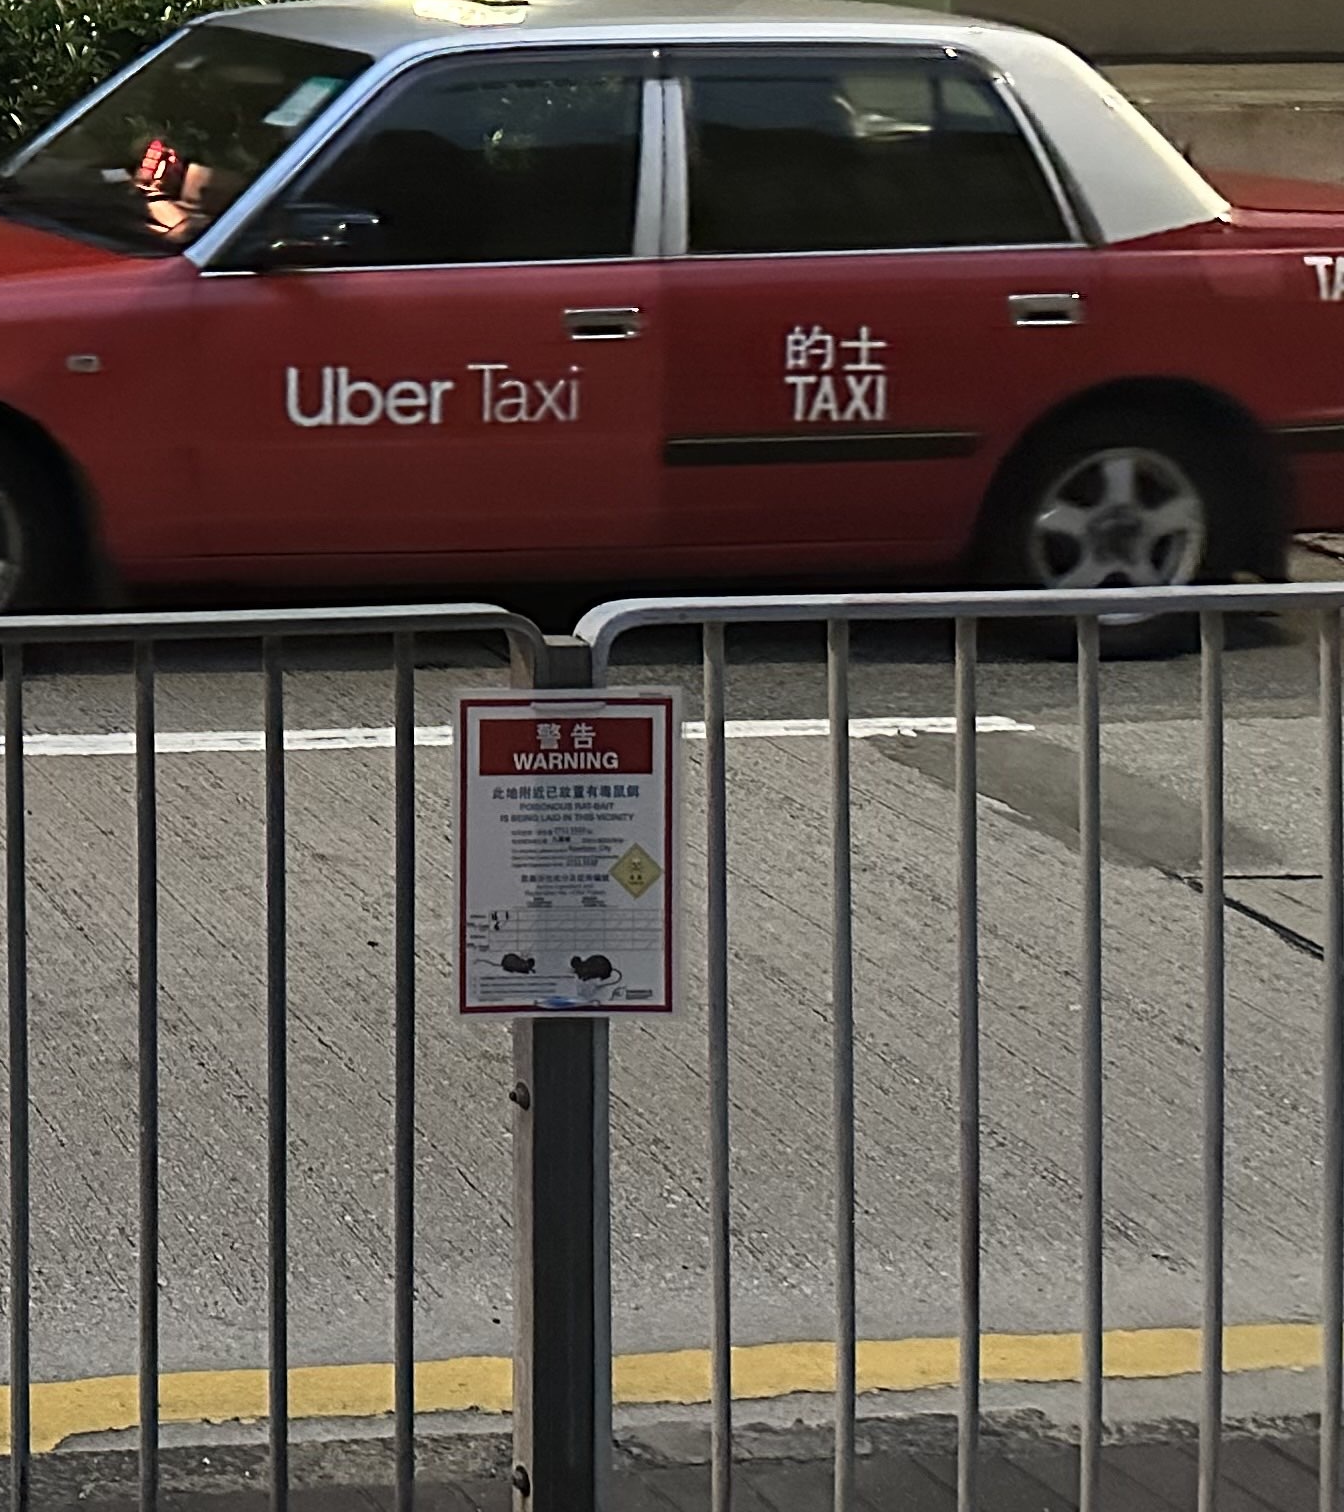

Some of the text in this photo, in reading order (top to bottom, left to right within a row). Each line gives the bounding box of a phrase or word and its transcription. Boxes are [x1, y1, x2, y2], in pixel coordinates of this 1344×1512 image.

[785, 326, 887, 372] 的士
[286, 364, 583, 427] Uber Taxi
[785, 375, 888, 421] TAXI
[536, 721, 597, 750] 警告
[513, 751, 620, 771] WARNING
